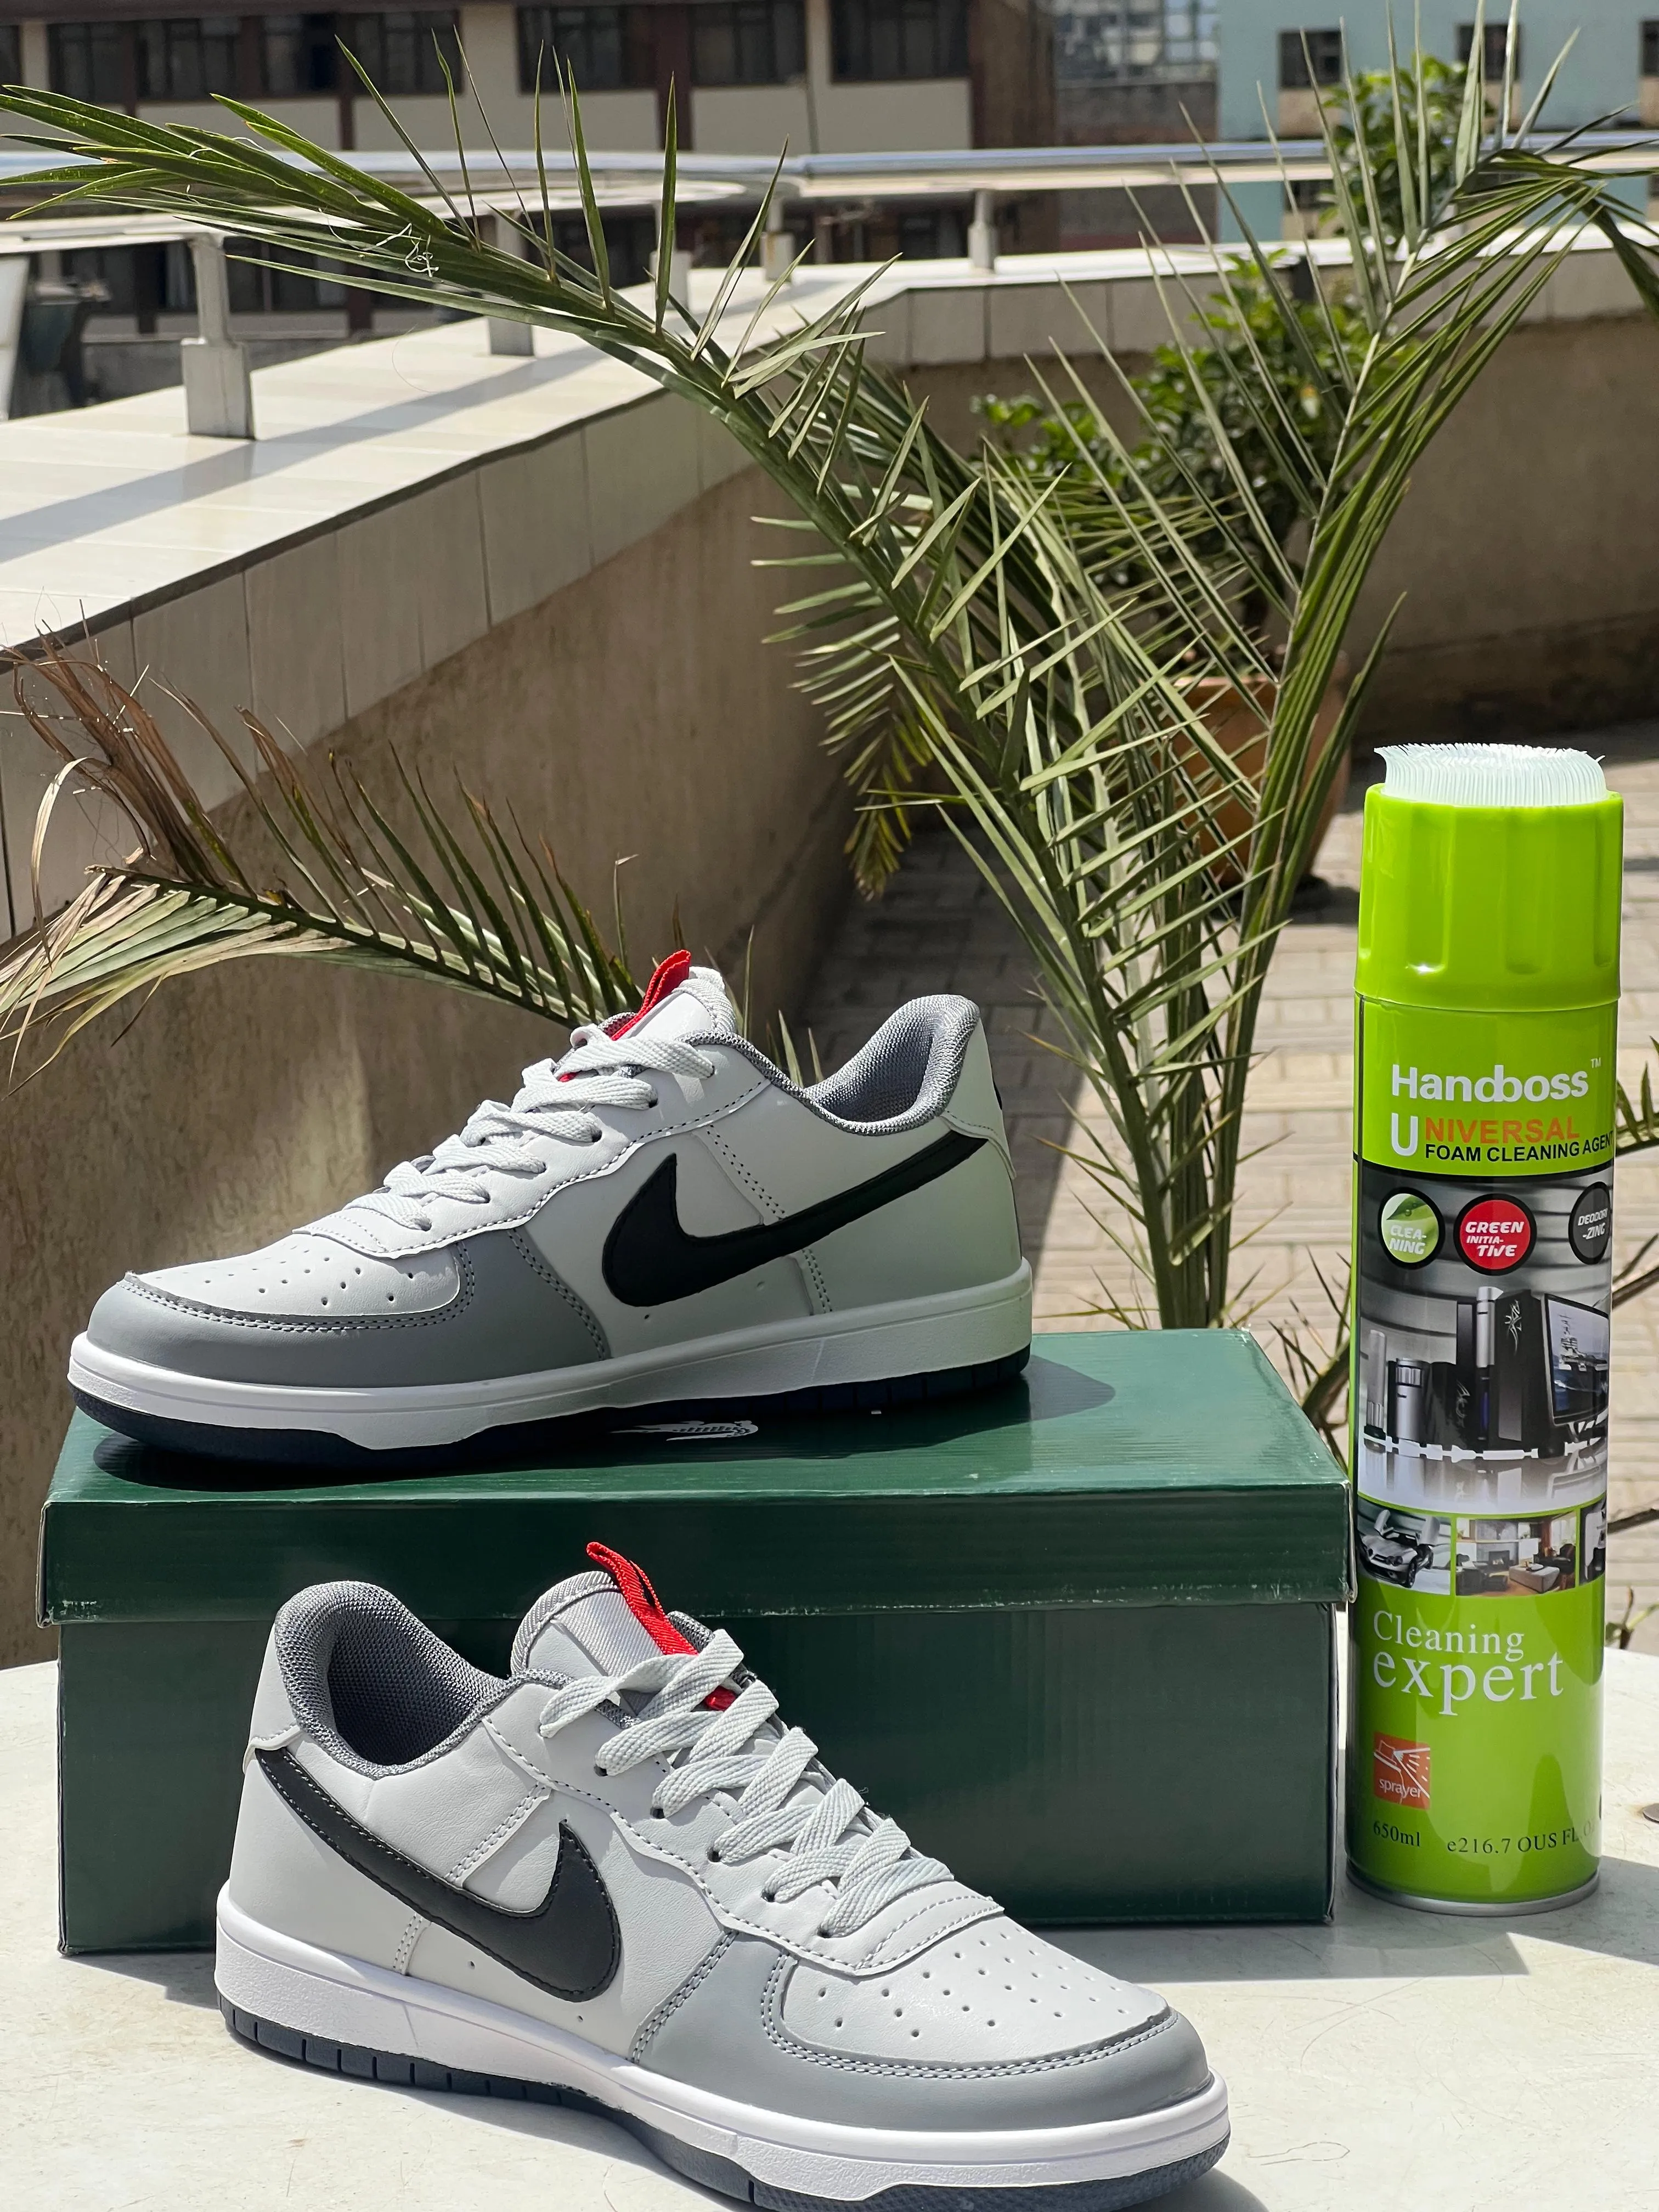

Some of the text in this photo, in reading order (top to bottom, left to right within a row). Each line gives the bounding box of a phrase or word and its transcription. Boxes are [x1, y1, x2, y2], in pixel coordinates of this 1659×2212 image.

[1392, 1064, 1589, 1102] Handboss
[1426, 1144, 1481, 1161] FOAM
[1487, 1142, 1580, 1162] CLEANING
[1390, 1224, 1427, 1240] CLEA-
[1465, 1222, 1525, 1234] GREEN
[1389, 1239, 1425, 1255] NING
[1466, 1235, 1504, 1245] INITIA-
[1477, 1244, 1518, 1257] TIVE
[1373, 1610, 1525, 1662] Cleaning
[1373, 1651, 1564, 1716] expert
[1379, 1778, 1423, 1799] sprayer
[1373, 1820, 1421, 1848] 650ml
[1447, 1837, 1511, 1854] e216.7
